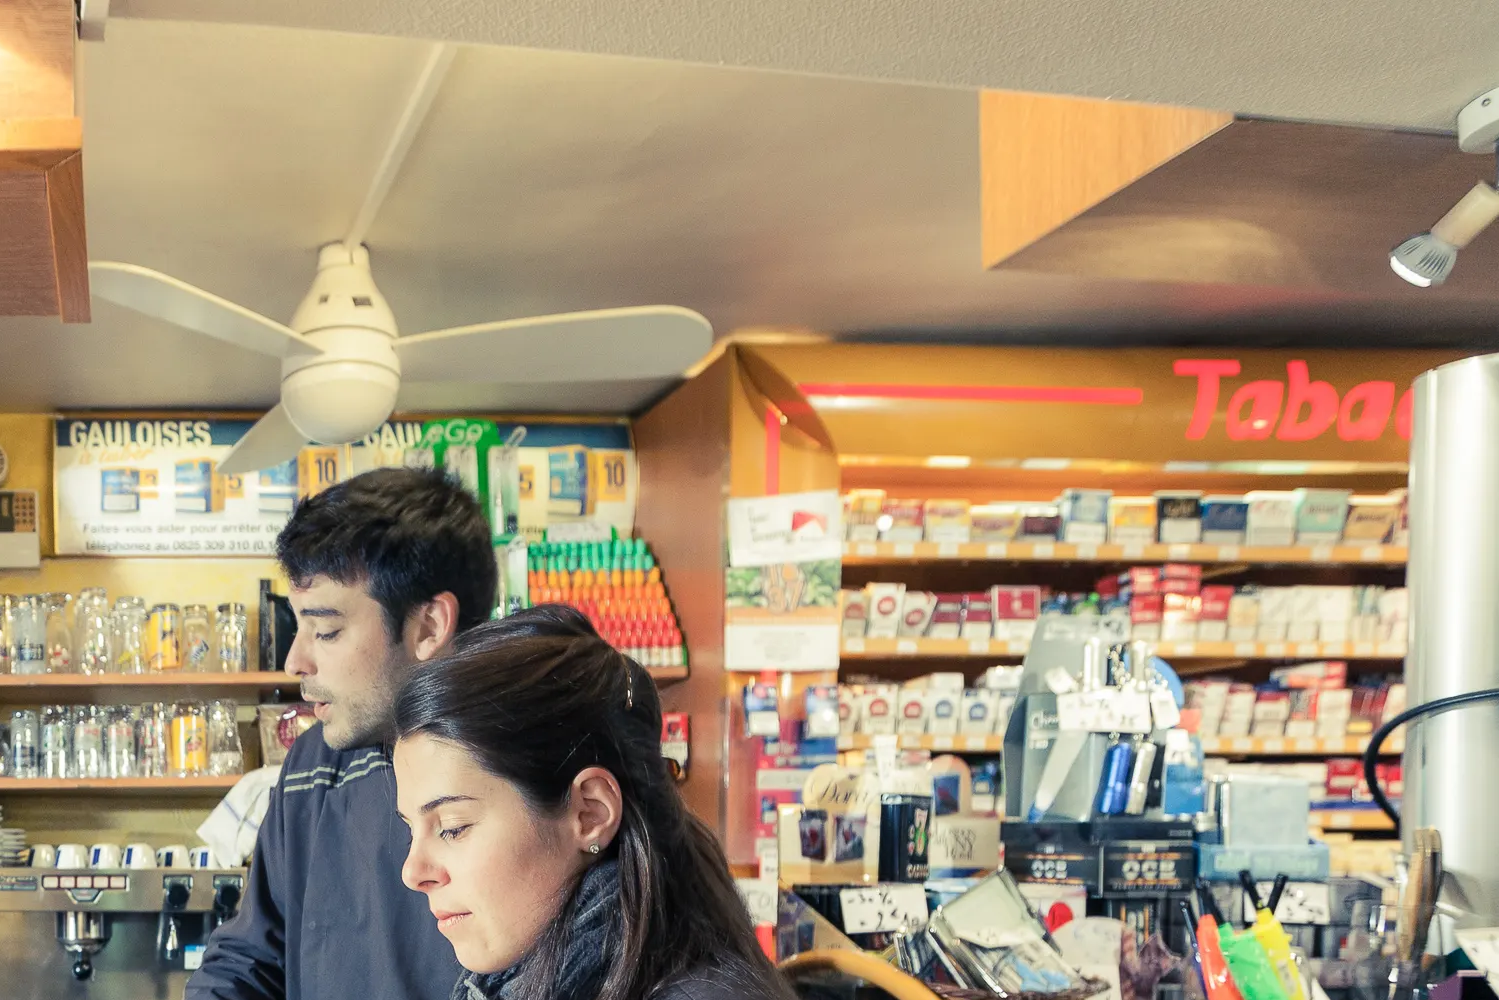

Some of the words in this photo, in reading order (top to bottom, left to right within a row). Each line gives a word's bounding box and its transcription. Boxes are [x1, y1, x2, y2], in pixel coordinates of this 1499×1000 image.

[69, 421, 212, 447] GAULOISES
[314, 458, 337, 484] 10
[604, 460, 626, 488] 10
[156, 523, 186, 534] aider
[190, 525, 217, 537] pour
[221, 522, 261, 534] arrêter
[85, 540, 151, 553] téléphonez
[154, 543, 170, 551] au
[205, 541, 225, 551] 309
[1122, 859, 1176, 880] OCB
